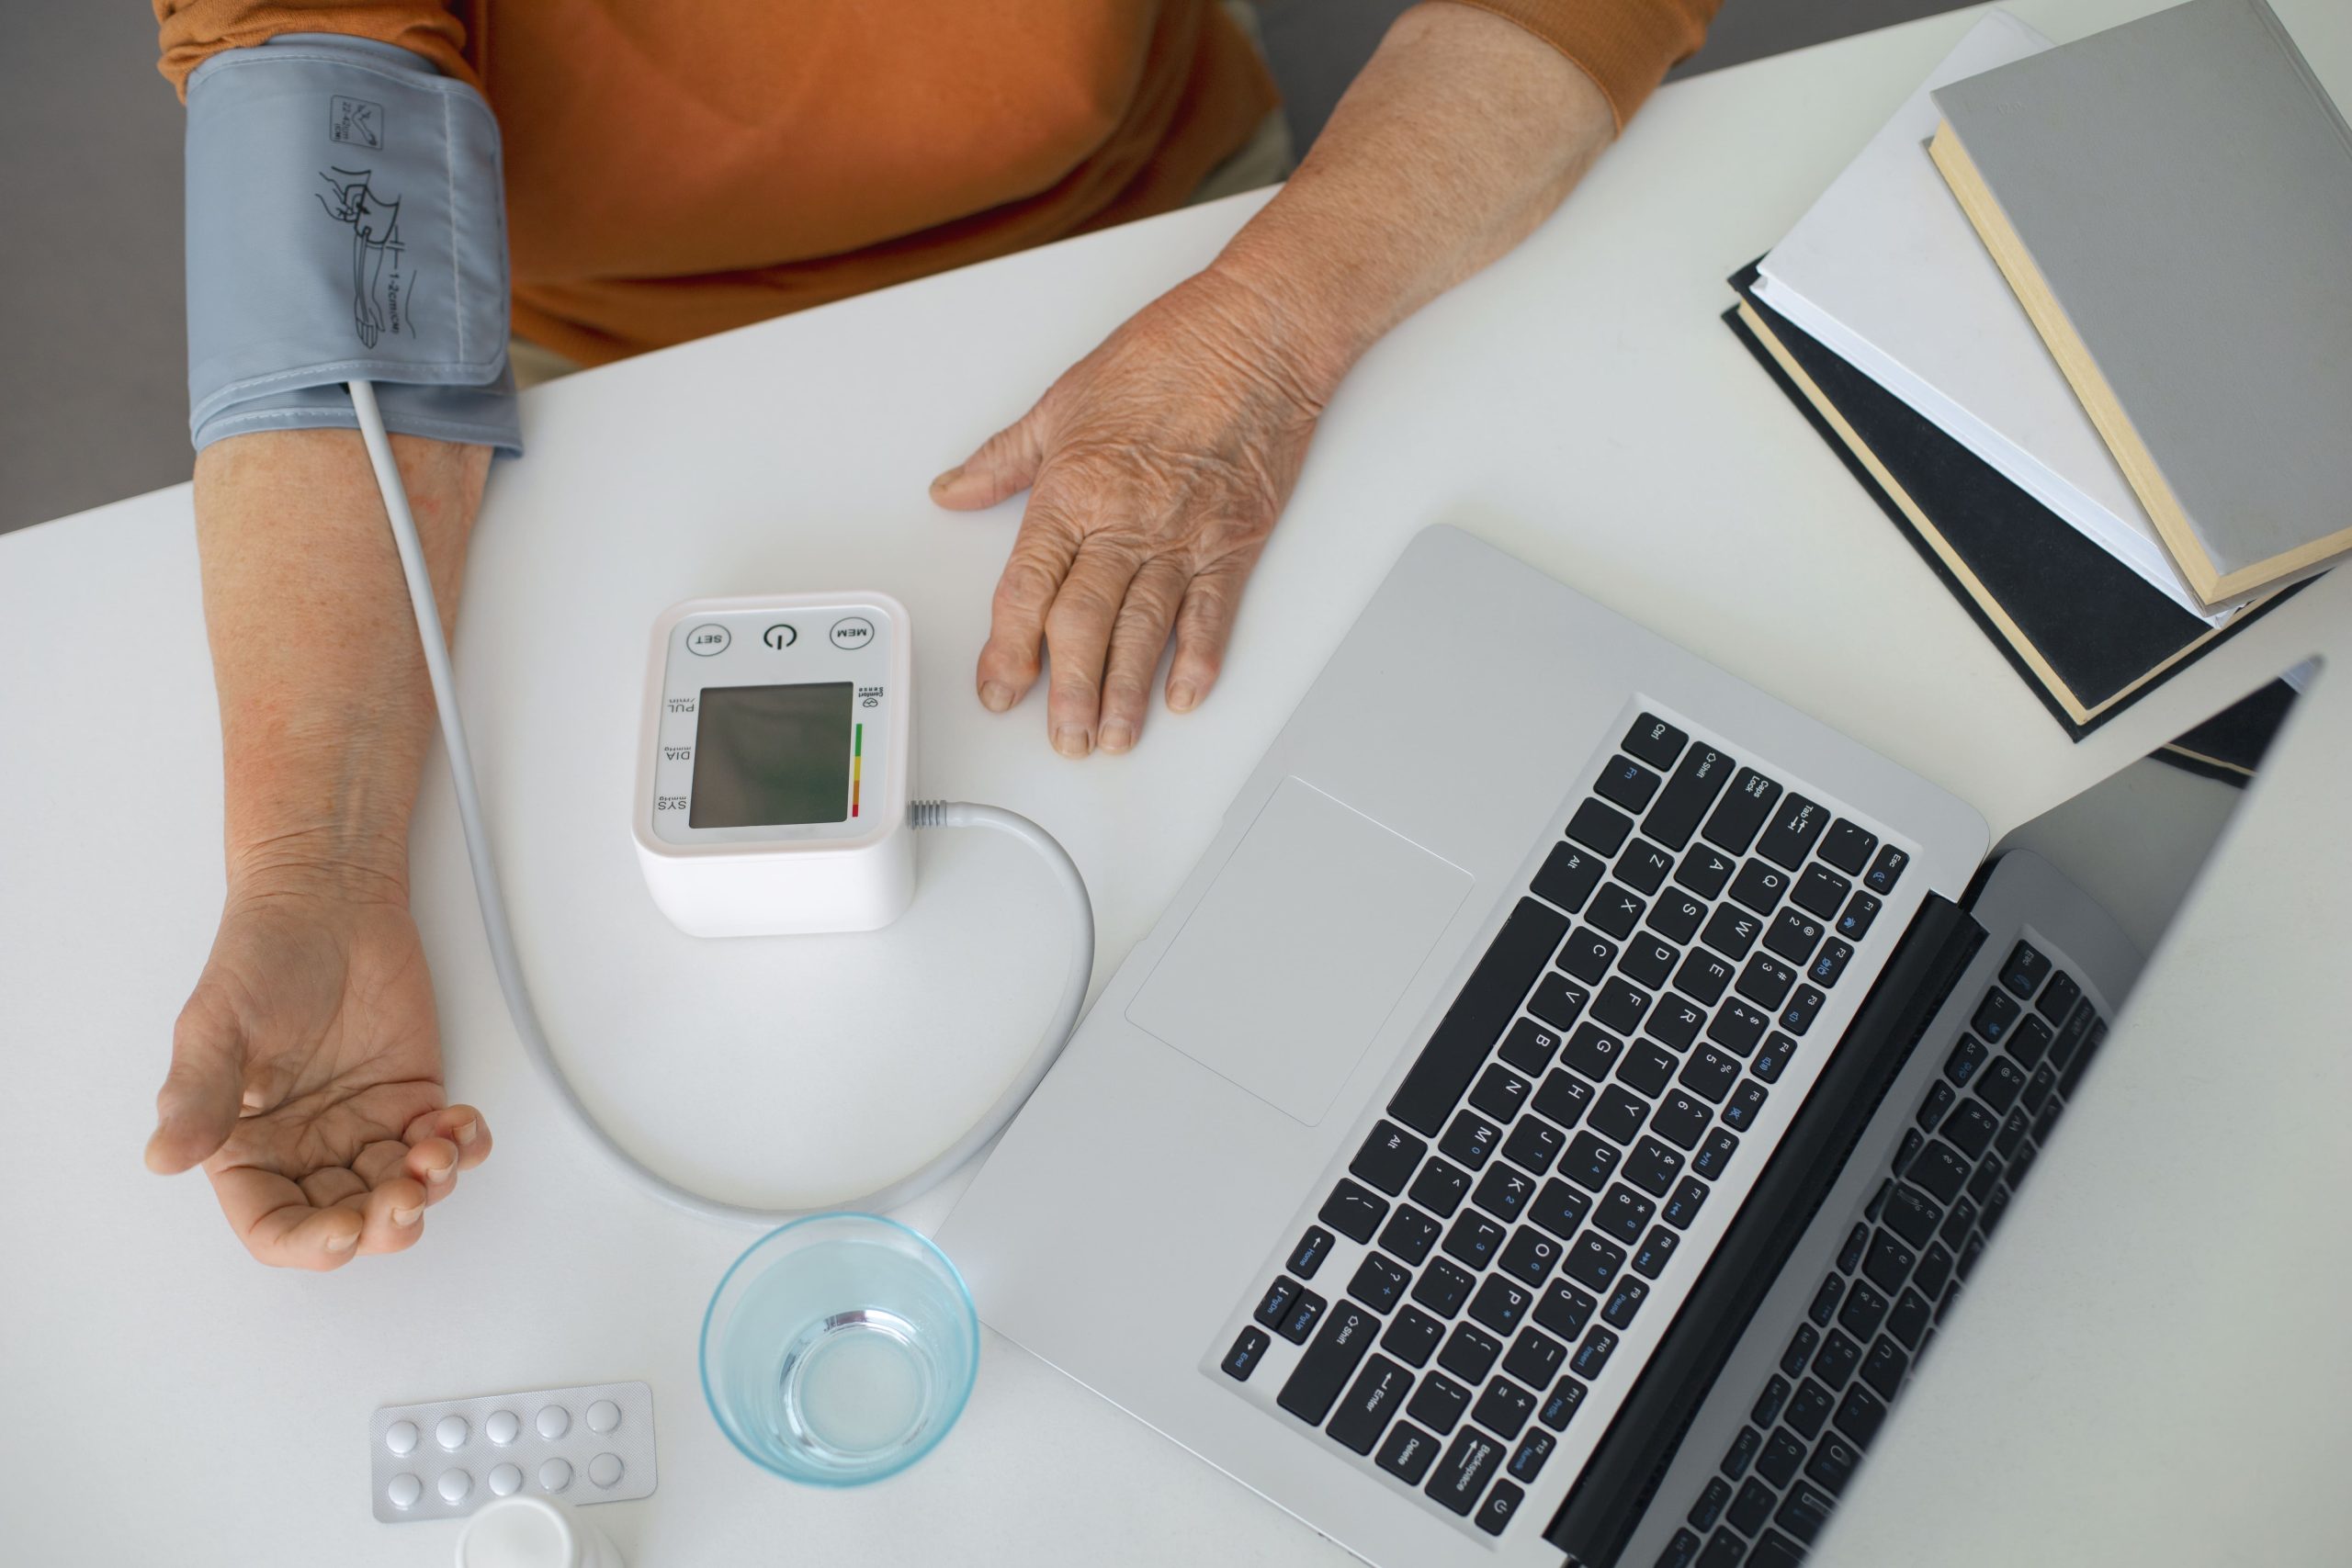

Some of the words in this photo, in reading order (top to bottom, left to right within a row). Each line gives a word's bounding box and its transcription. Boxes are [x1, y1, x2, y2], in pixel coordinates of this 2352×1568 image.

[837, 628, 867, 637] MEM
[695, 634, 723, 645] SET
[858, 690, 884, 700] Comfort
[667, 703, 695, 714] PUL
[1650, 723, 1666, 740] Ctrl
[666, 750, 691, 761] DIA
[1623, 766, 1638, 780] Fn
[1696, 761, 1711, 779] Shift
[1745, 775, 1760, 793] Lock
[1753, 780, 1770, 798] Caps
[658, 800, 687, 811] SYS
[1800, 805, 1815, 818] Tab
[1567, 854, 1580, 869] Alt
[1649, 853, 1665, 868] Z
[1709, 858, 1724, 871] A
[1889, 853, 1902, 868] Esc
[1761, 874, 1779, 888] Q
[1620, 898, 1637, 914] X
[1682, 903, 1697, 916] S
[1863, 900, 1874, 911] F1
[1789, 916, 1801, 926] 2
[1735, 920, 1753, 938] W
[1803, 926, 1815, 937] @
[1592, 944, 1607, 957] C
[1655, 947, 1670, 961] D
[1836, 947, 1847, 958] F2
[1709, 963, 1725, 977] E
[1761, 963, 1772, 972] 3
[1777, 971, 1787, 981] #
[1565, 991, 1580, 1004] V
[1629, 992, 1642, 1007] F
[1807, 995, 1818, 1006] F3
[1679, 1009, 1697, 1023] R
[1734, 1008, 1744, 1018] 4
[1749, 1016, 1759, 1025] $
[1535, 1033, 1551, 1047] B
[1596, 1039, 1611, 1053] G
[1779, 1042, 1790, 1053] F4
[1654, 1057, 1668, 1070] T
[1705, 1054, 1717, 1065] 5
[1720, 1064, 1732, 1074] %
[1505, 1079, 1522, 1095] N
[1567, 1084, 1585, 1100] H
[1749, 1090, 1760, 1102] F5
[1624, 1104, 1640, 1117] Y
[1678, 1100, 1689, 1111] 6
[1474, 1126, 1492, 1144] M
[1540, 1131, 1553, 1144] J
[1387, 1134, 1401, 1149] Alt
[1720, 1138, 1732, 1150] F6
[1595, 1148, 1611, 1163] U
[1650, 1147, 1661, 1157] 7
[1663, 1156, 1675, 1165] &
[1591, 1166, 1600, 1174] 4
[1657, 1172, 1666, 1181] 7
[1452, 1179, 1460, 1187] <
[1508, 1177, 1525, 1193] K
[1505, 1195, 1515, 1204] 2
[1619, 1194, 1631, 1204] 8
[1690, 1188, 1702, 1200] F7
[1564, 1210, 1574, 1219] 5
[1423, 1224, 1431, 1234] >
[1478, 1224, 1495, 1234] L
[1626, 1220, 1636, 1229] 8
[1476, 1243, 1486, 1251] 3
[1590, 1241, 1602, 1252] 9
[1660, 1236, 1672, 1248] F8
[1534, 1243, 1550, 1258] O
[1606, 1251, 1616, 1259] (
[1299, 1247, 1316, 1267] Home
[1374, 1260, 1384, 1270] /
[1440, 1266, 1450, 1275] ;
[1531, 1262, 1540, 1271] 6
[1390, 1272, 1401, 1282] ?
[1598, 1267, 1608, 1276] 9
[1383, 1287, 1391, 1295] +
[1630, 1287, 1642, 1299] F9
[1509, 1290, 1521, 1305] P
[1267, 1294, 1283, 1314] PgDn
[1609, 1293, 1627, 1315] Pause
[1295, 1312, 1311, 1331] PgUp
[1336, 1325, 1352, 1345] Shift
[1596, 1337, 1611, 1353] F10
[1235, 1351, 1249, 1368] End
[1577, 1346, 1595, 1367] Insert
[1498, 1386, 1508, 1397] =
[1566, 1387, 1579, 1404] F11
[1366, 1388, 1385, 1412] Enter
[1517, 1398, 1525, 1407] +
[1397, 1438, 1419, 1466] Delete
[1535, 1438, 1548, 1454] F12
[1455, 1443, 1491, 1492] Backspace
